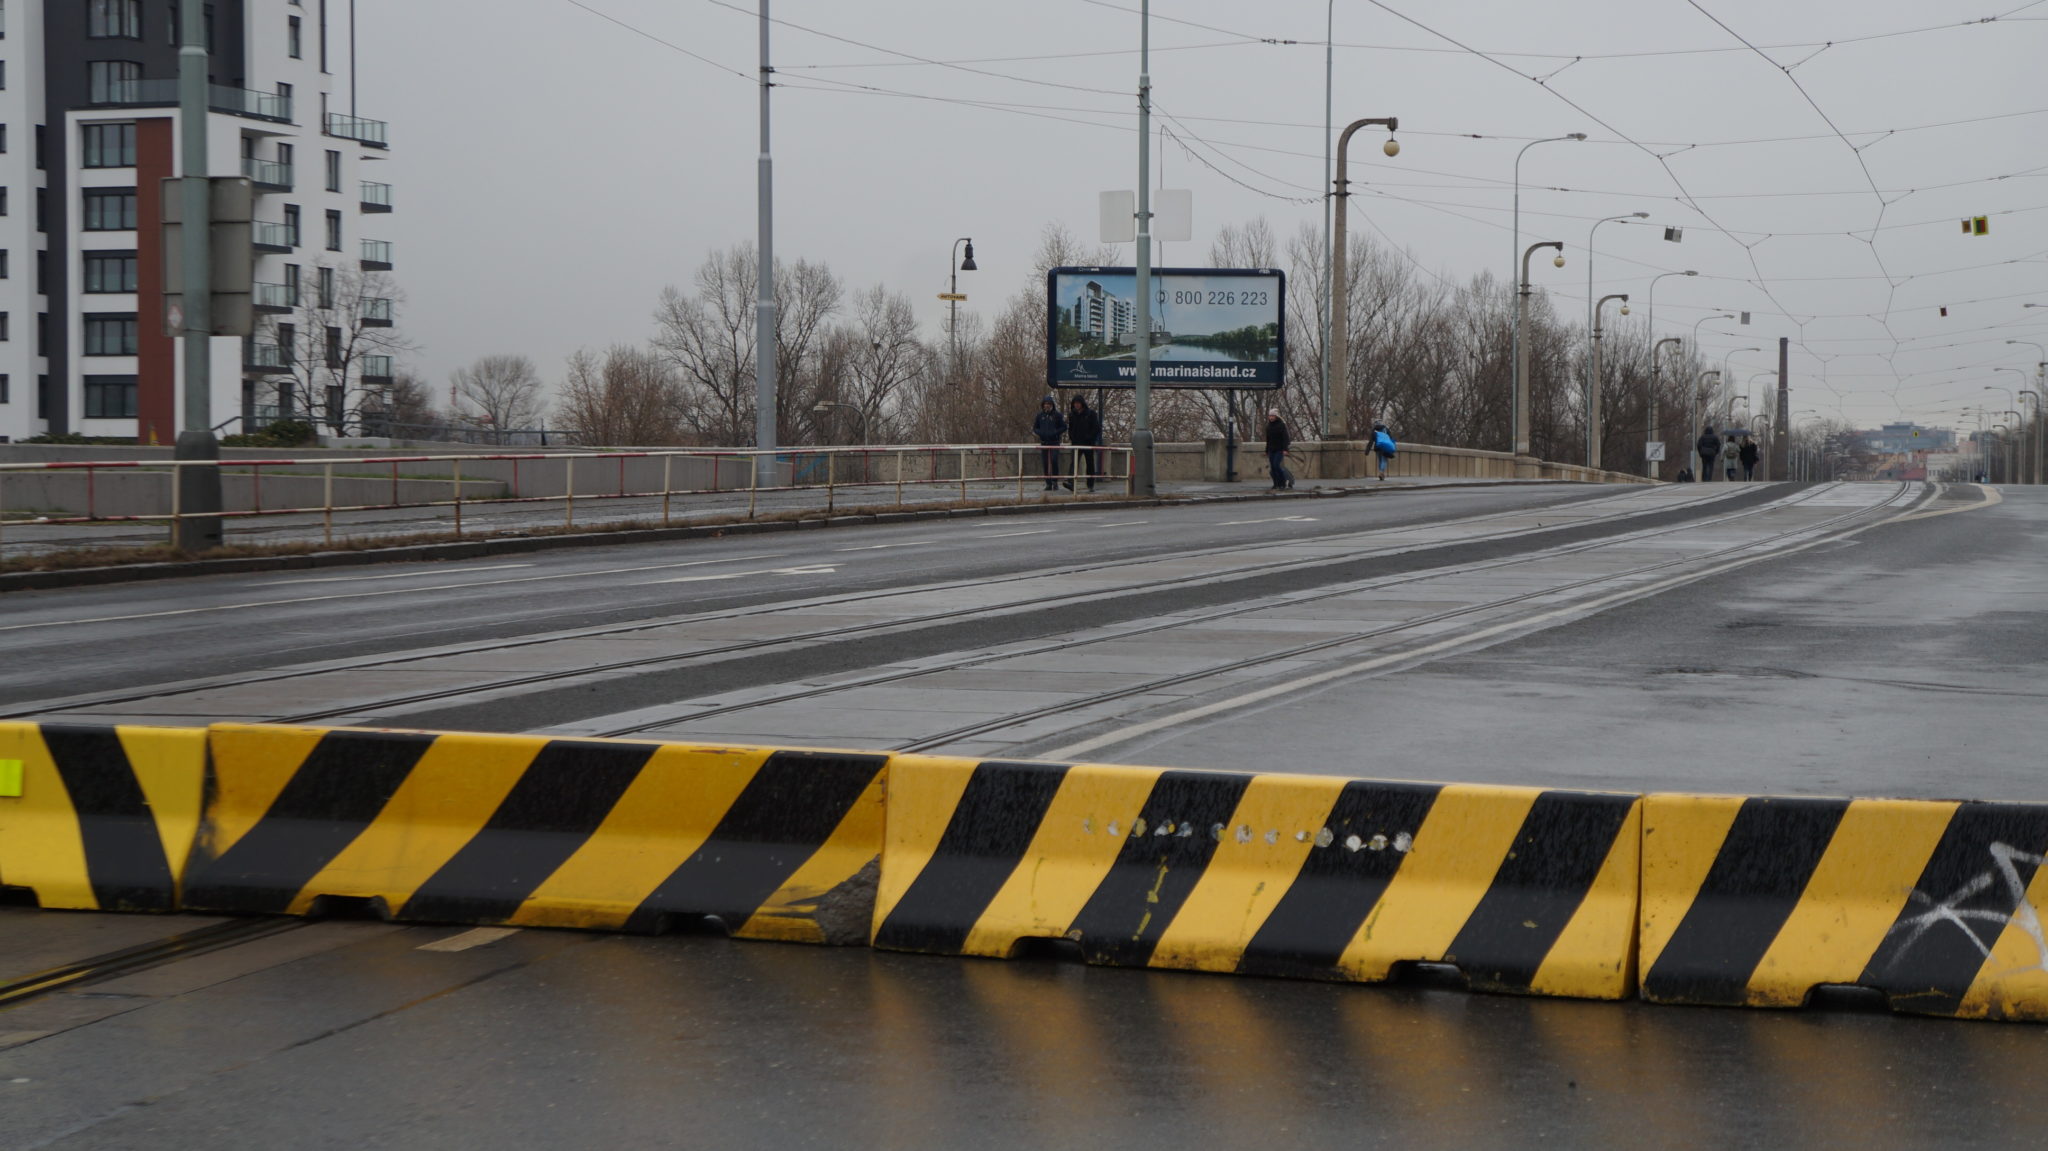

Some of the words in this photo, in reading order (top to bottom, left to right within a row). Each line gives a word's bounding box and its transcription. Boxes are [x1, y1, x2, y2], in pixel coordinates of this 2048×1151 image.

[1175, 290, 1202, 305] 800
[1208, 291, 1235, 305] 226
[1241, 291, 1268, 306] 223
[1118, 365, 1257, 378] ww.marinaisland.cz
